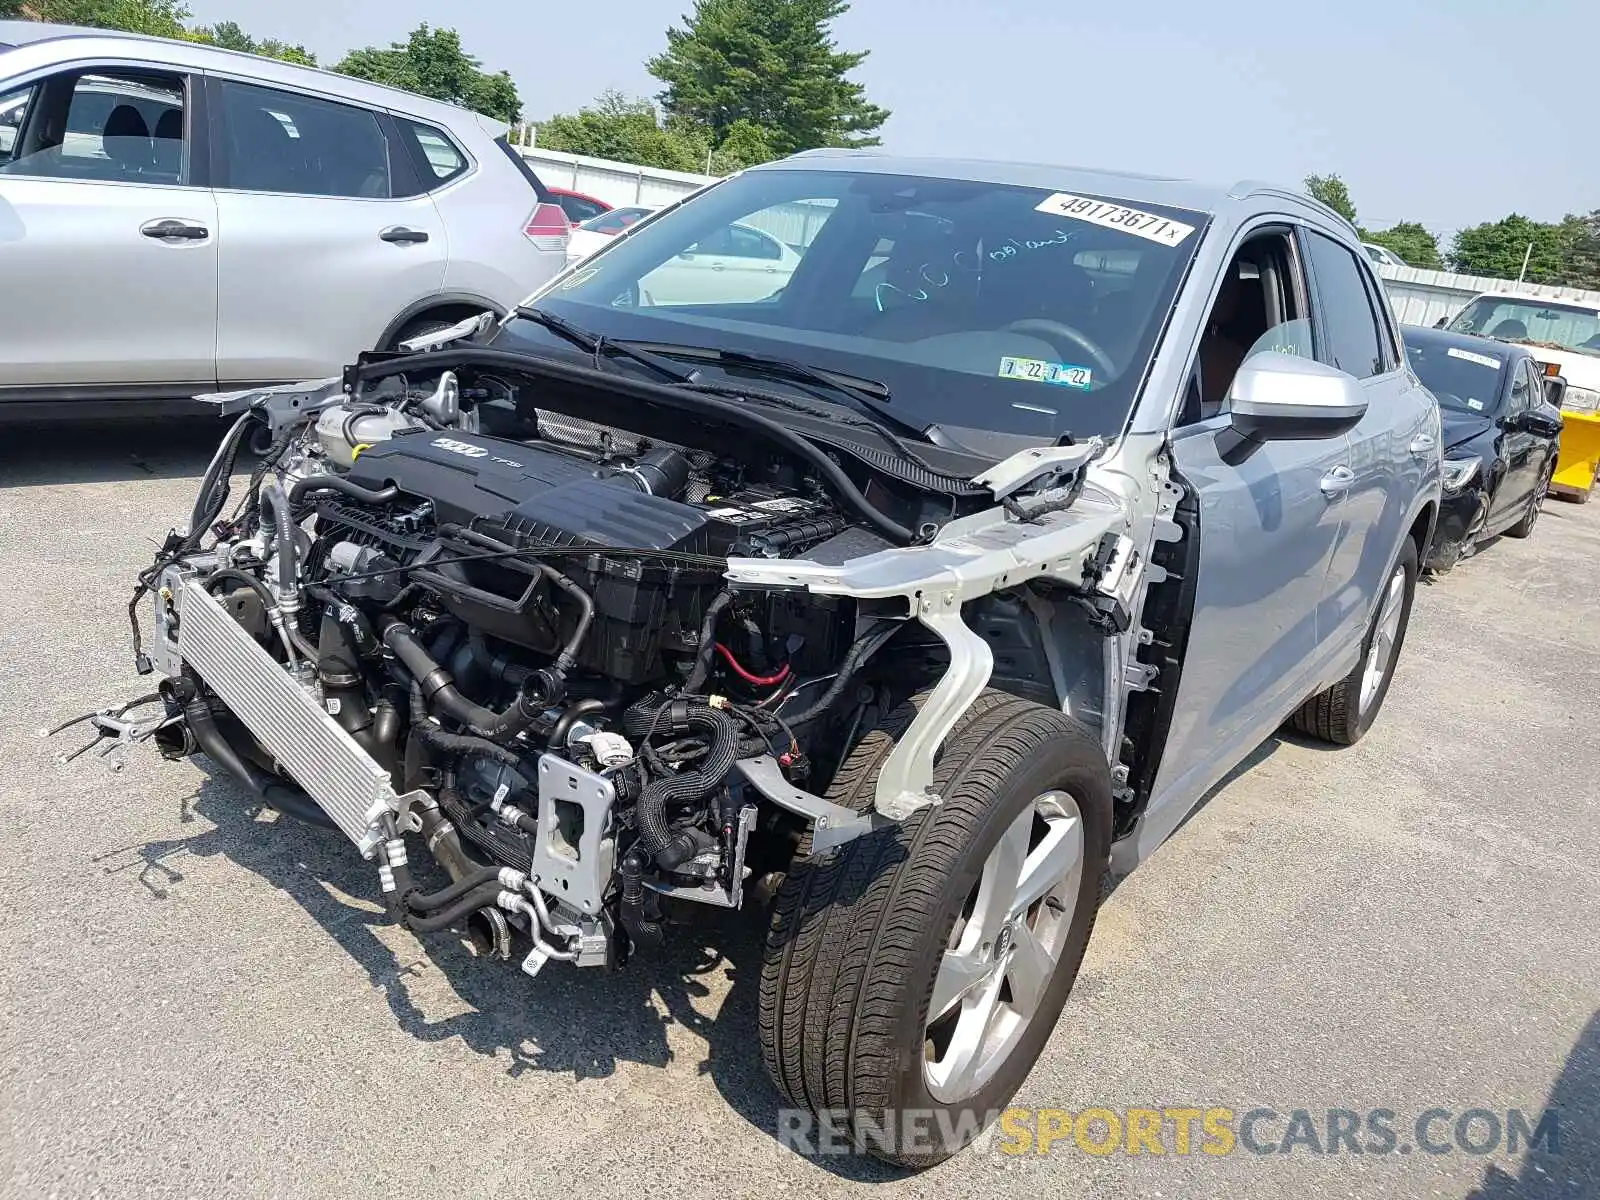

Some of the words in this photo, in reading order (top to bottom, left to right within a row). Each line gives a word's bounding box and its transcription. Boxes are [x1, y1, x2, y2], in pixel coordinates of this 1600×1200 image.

[1060, 198, 1171, 235] 49173671
[1028, 363, 1041, 378] 22
[1072, 369, 1086, 385] 22
